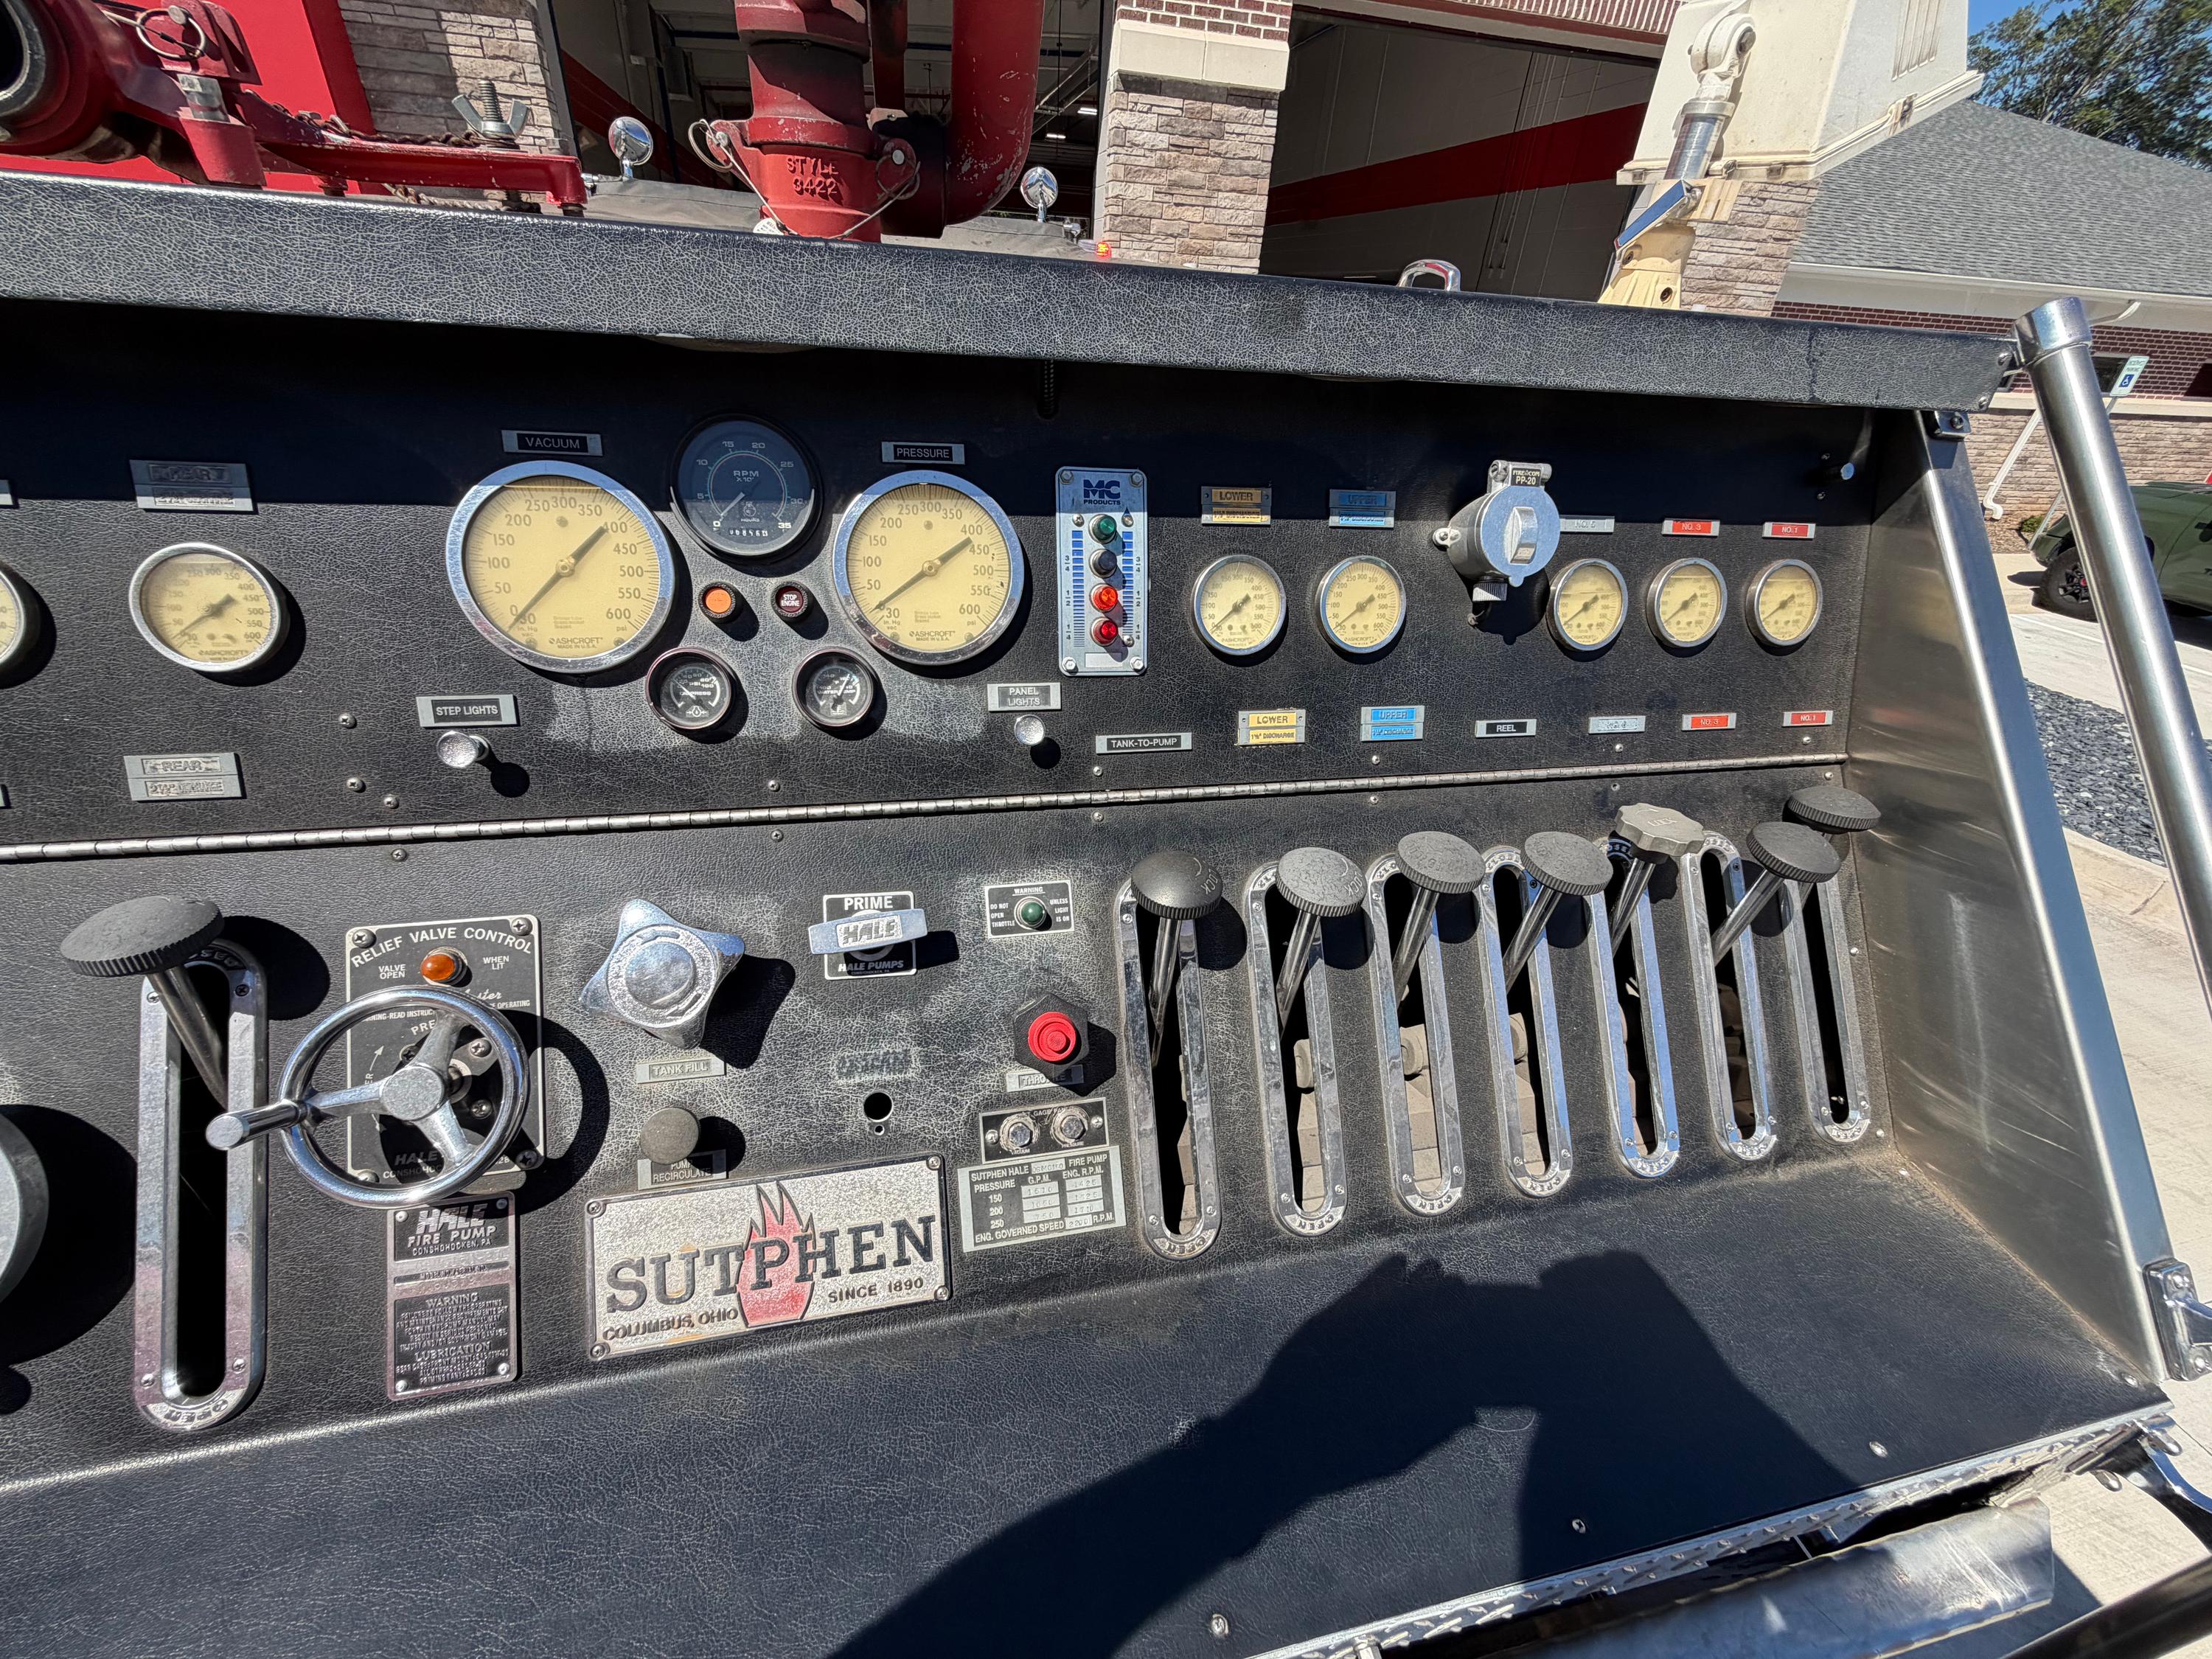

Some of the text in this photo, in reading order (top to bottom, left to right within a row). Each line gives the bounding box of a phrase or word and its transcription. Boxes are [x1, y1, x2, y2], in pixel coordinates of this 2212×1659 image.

[787, 156, 838, 175] STYLE
[793, 177, 838, 194] 3422
[526, 437, 580, 448] VACUUM
[897, 448, 950, 458] PRESSURE
[1516, 476, 1536, 484] PP-20
[1083, 479, 1120, 499] MC
[1220, 492, 1253, 501] LOWER
[526, 500, 550, 512] 250
[552, 497, 577, 508] 300
[920, 502, 942, 512] 300
[578, 504, 602, 516] 350
[898, 504, 919, 515] 250
[942, 509, 962, 520] 350
[505, 515, 532, 526] 200
[880, 518, 902, 528] 200
[961, 524, 983, 535] 400
[493, 535, 515, 546] 150
[869, 536, 886, 546] 150
[613, 543, 637, 554] 450
[970, 544, 990, 554] 450
[488, 558, 509, 568] 100
[863, 557, 881, 566] 100
[620, 566, 643, 577] 500
[973, 566, 993, 575] 500
[495, 583, 511, 594] 50
[867, 580, 880, 590] 50
[618, 588, 641, 599] 550
[606, 608, 631, 619] 600
[886, 608, 900, 618] 30
[959, 605, 980, 614] 600
[1009, 687, 1038, 696] PANEL
[1009, 697, 1040, 706] LIGHTS
[436, 704, 498, 717] STEP LIGHTS
[1257, 716, 1288, 724] LOWER
[1111, 738, 1177, 748] TANK-TO-PUMP
[161, 760, 203, 771] REAR
[844, 896, 893, 910] PRIME
[842, 917, 897, 945] HALE
[351, 928, 533, 967] RELIEF VALVE CONTROL
[483, 956, 509, 964] WHEN
[838, 960, 904, 972] HALE PUMPS
[380, 971, 406, 979] OPEN
[498, 1000, 530, 1009] OPERATING
[653, 1062, 708, 1076] TANK FILL
[394, 1151, 438, 1165] HALE
[971, 1153, 1107, 1182] SUTPHEN HALE FIRE PUMP
[653, 1168, 712, 1183] RECIRCULATE
[974, 1166, 1104, 1193] PRESSURE G.P.M. ENG. R.P.M.
[1527, 1178, 1561, 1192] OPEN
[989, 1194, 1002, 1203] 150
[1417, 1194, 1453, 1210] OPEN
[990, 1207, 1004, 1216] 200
[417, 1203, 488, 1234] HALE
[990, 1219, 1004, 1228] 250
[1297, 1215, 1334, 1229] OPEN
[975, 1213, 1114, 1242] ENG. GOVERNED SPEED 2200 R.P.M.
[407, 1225, 497, 1248] FIRE PUMP
[413, 1240, 479, 1256] CONSHOHOCKEN,
[1166, 1237, 1206, 1253] OPEN
[607, 1215, 936, 1313] SUTPHEN
[827, 1276, 924, 1304] SINCE 1890
[426, 1293, 478, 1308] WARNING
[602, 1307, 739, 1341] COLUMBUS, OHIO
[414, 1340, 491, 1361] LUBRICATION
[164, 1399, 229, 1422] OPEN
